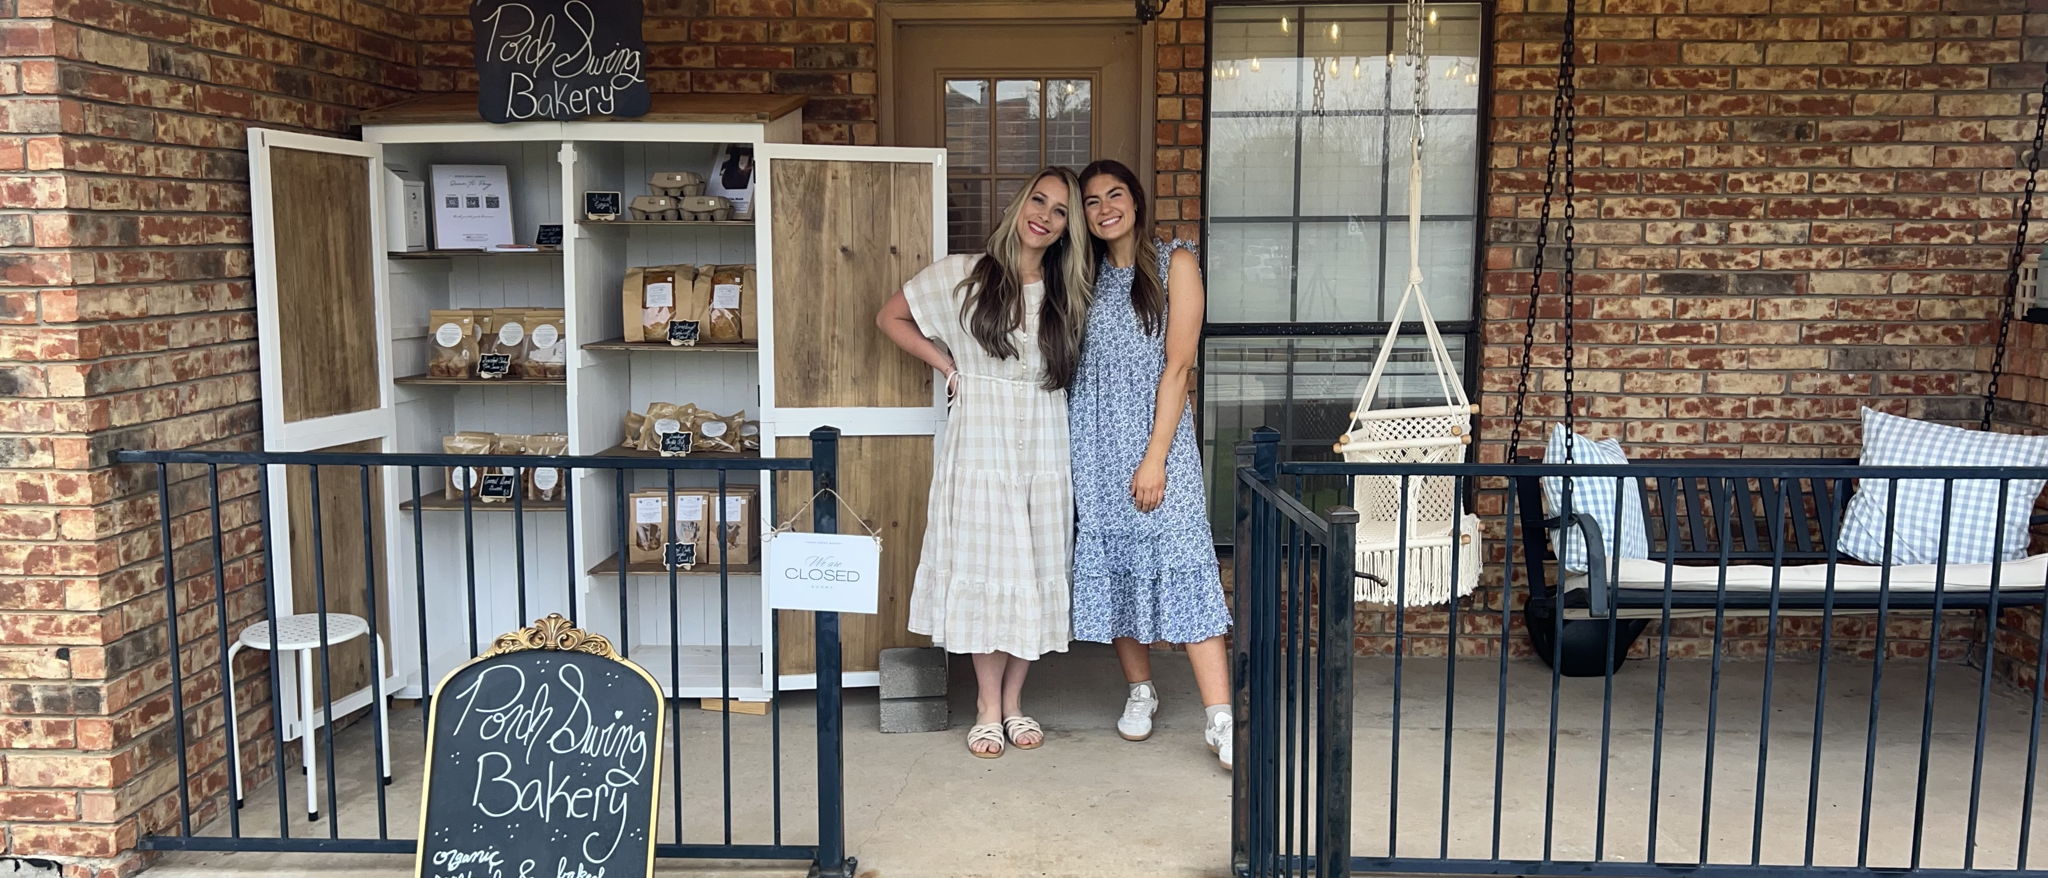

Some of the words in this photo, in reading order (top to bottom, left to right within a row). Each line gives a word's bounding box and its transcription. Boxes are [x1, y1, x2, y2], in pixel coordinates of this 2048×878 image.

[482, 3, 556, 78] Porch
[552, 0, 645, 90] Swing
[506, 72, 615, 119] Bakery
[785, 567, 860, 582] CLOSED
[453, 664, 553, 764] Porch
[547, 663, 647, 787] Swing
[472, 751, 628, 864] Bakery
[433, 845, 504, 874] organic
